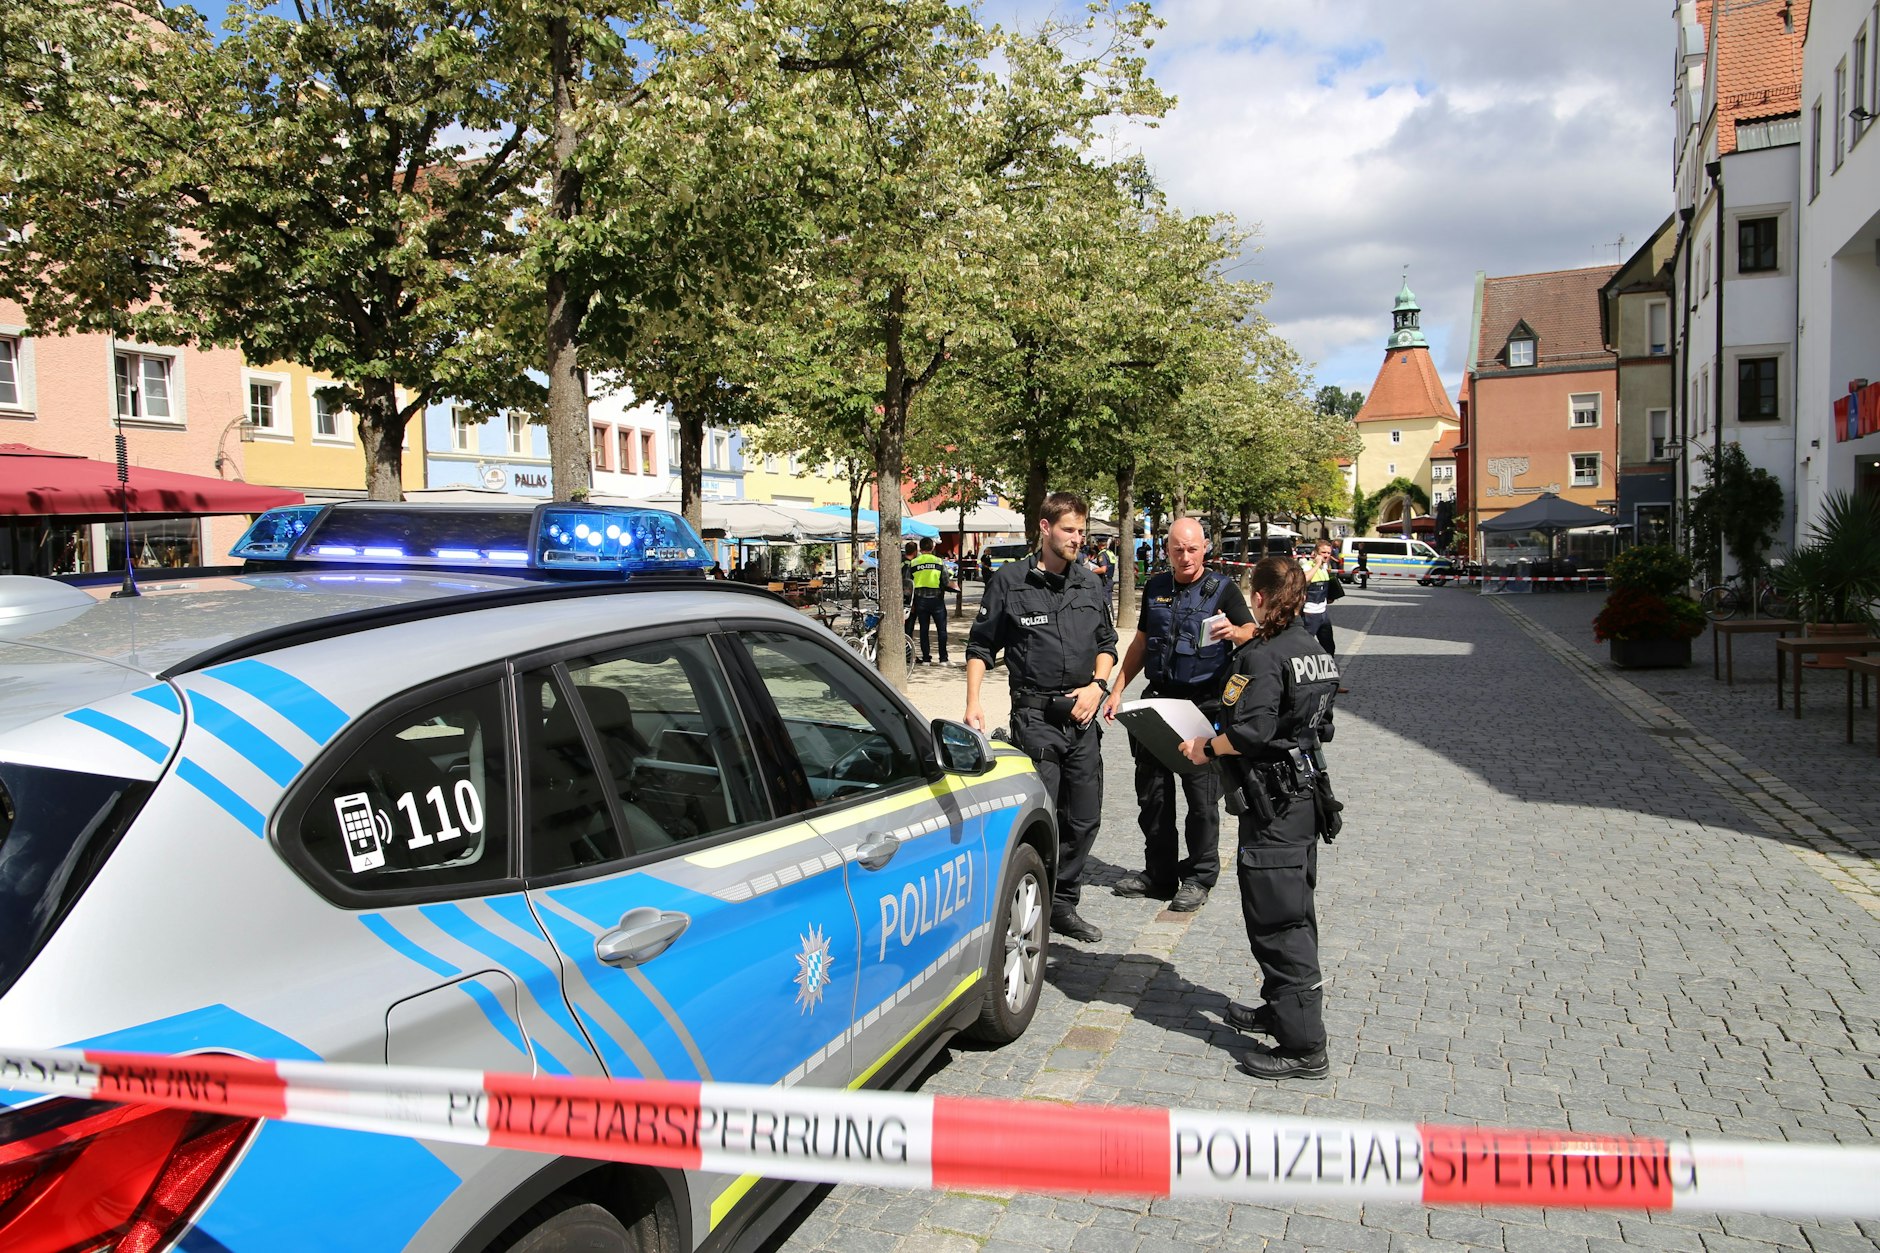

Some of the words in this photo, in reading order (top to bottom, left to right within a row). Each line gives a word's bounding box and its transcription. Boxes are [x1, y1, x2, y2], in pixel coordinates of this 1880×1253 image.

[515, 473, 547, 488] PALLAS
[1020, 615, 1049, 626] POLIZEI
[1291, 654, 1339, 683] POLIZE
[397, 779, 484, 849] 110
[879, 850, 973, 962] POLIZEI
[448, 1088, 907, 1163] POLIZEIABSPERRUNG
[1176, 1126, 1697, 1193] POLIZEIABSPERRUNG
